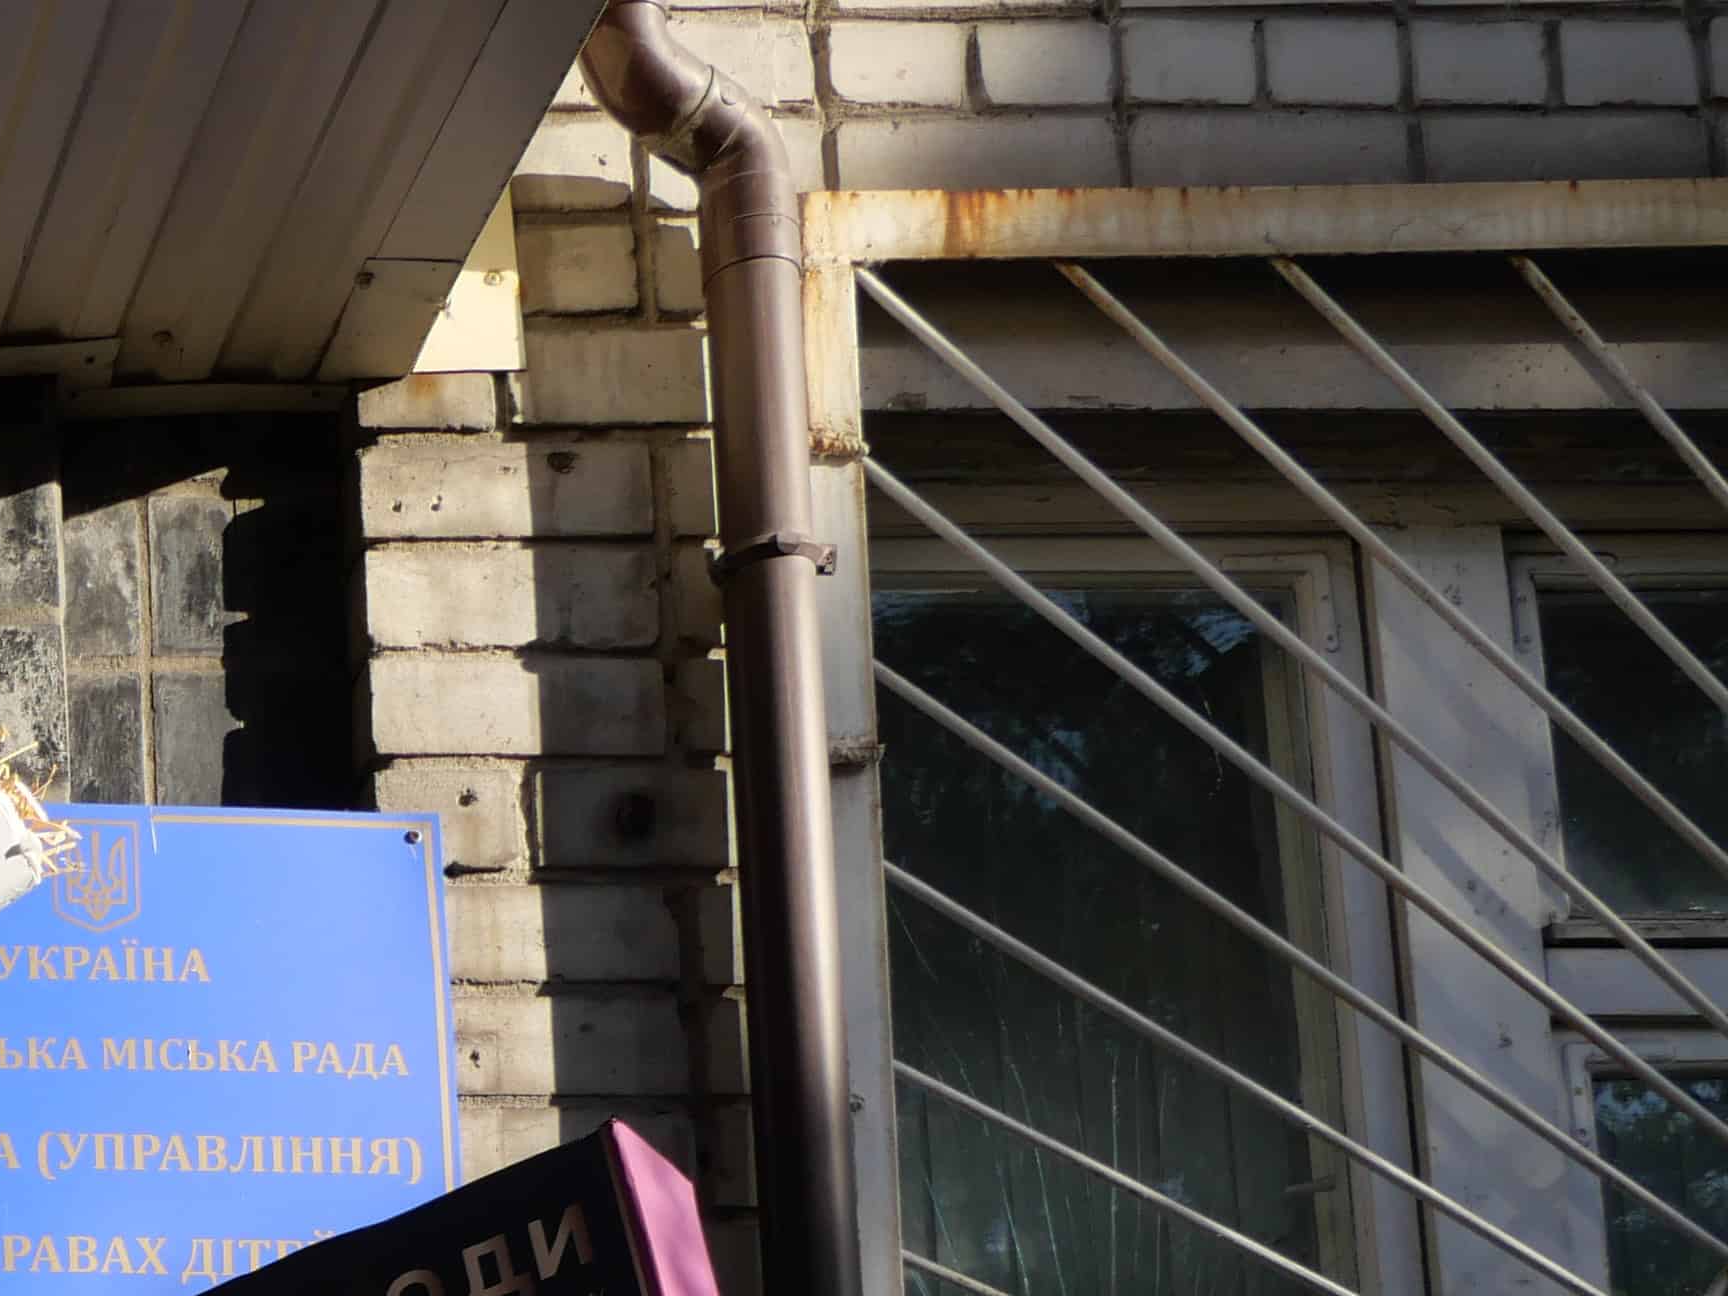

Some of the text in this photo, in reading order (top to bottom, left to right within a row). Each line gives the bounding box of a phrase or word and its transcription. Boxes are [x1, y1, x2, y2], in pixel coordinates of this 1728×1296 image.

[101, 1038, 280, 1074] МІСЬКА
[291, 1040, 410, 1080] РАДА
[35, 1130, 424, 1186] (УПРАВЛІННЯ)
[180, 1229, 336, 1286] ДІТ
